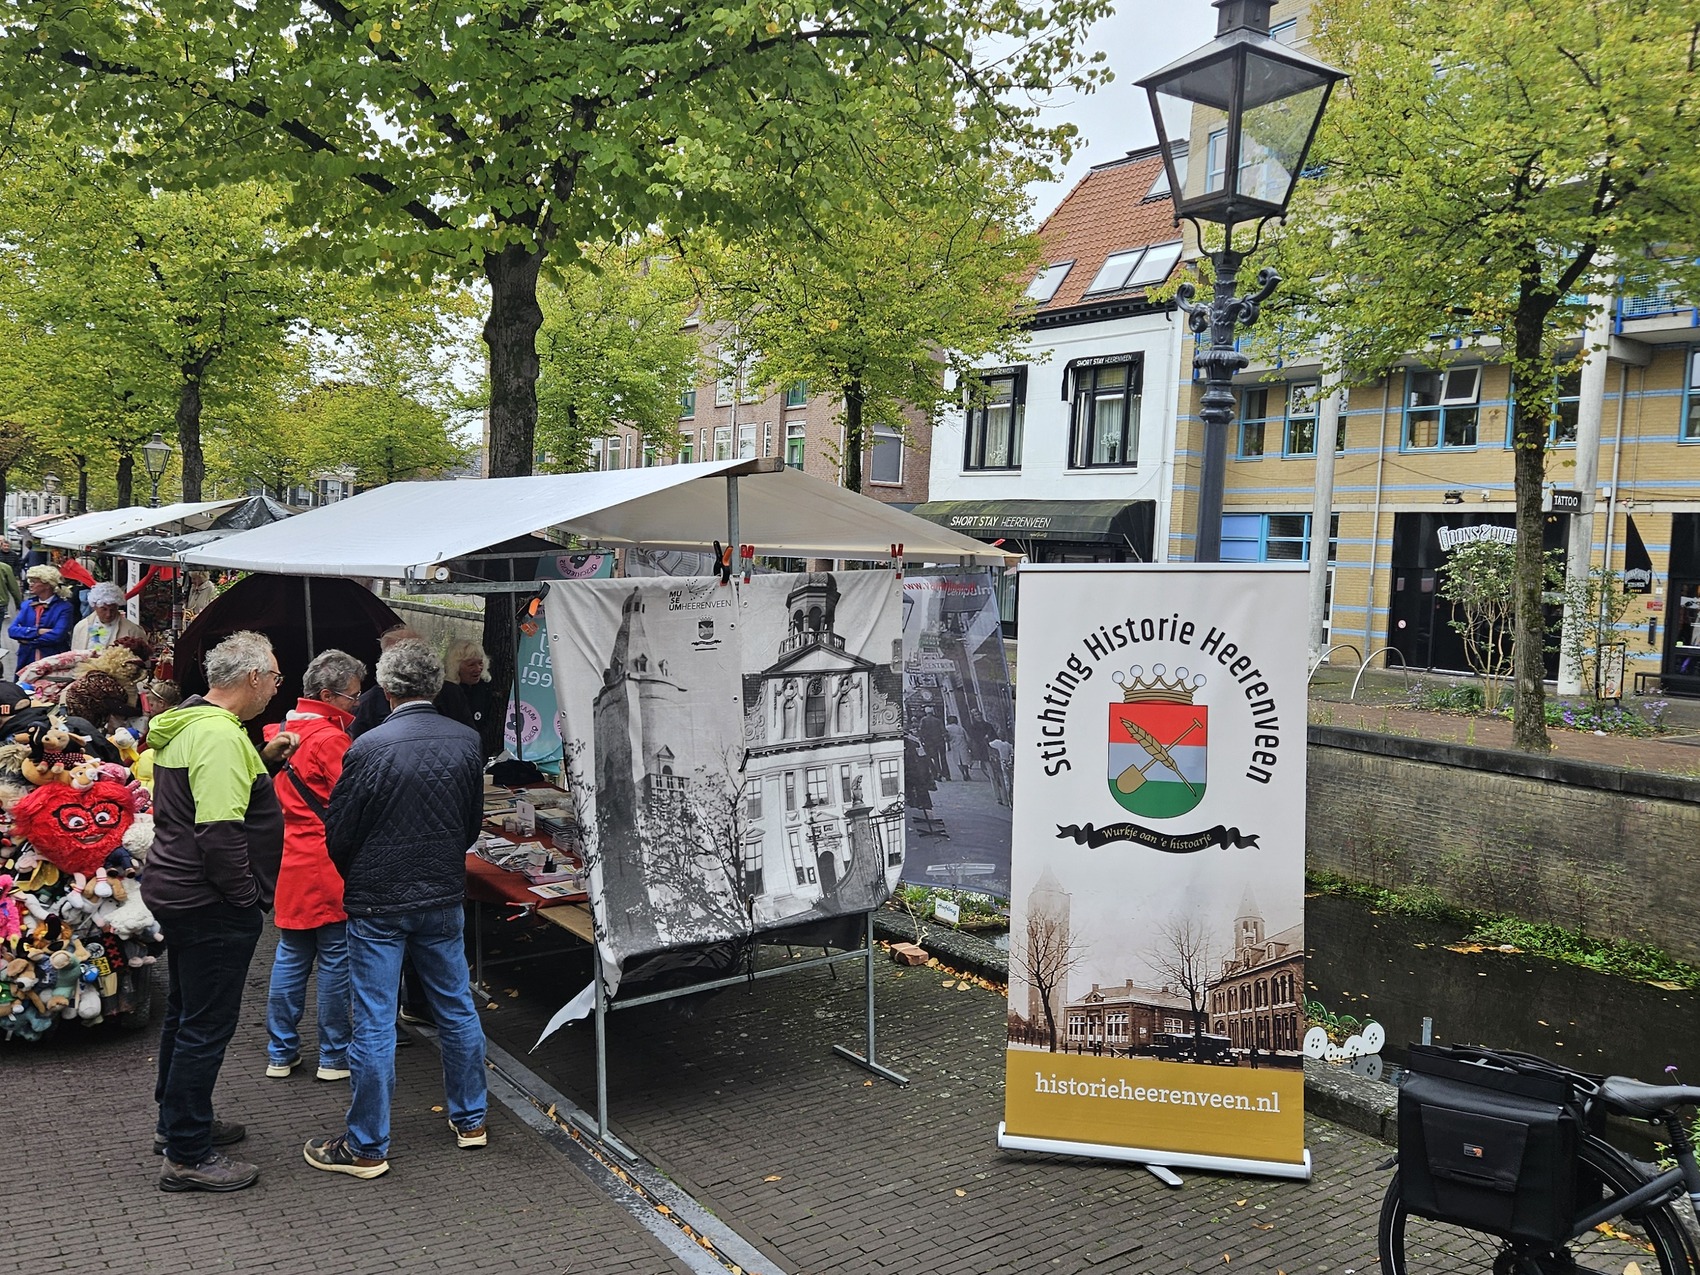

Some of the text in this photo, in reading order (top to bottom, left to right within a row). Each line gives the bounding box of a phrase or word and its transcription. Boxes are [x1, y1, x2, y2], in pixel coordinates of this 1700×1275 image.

[1076, 354, 1133, 367] SHORT STAY HEERENVEEN
[1554, 495, 1578, 507] TATTOO
[950, 516, 1051, 528] SHORT STAY HEERENVEEN
[1437, 525, 1479, 551] GOONS
[1037, 612, 1280, 784] Stichting Historie Heerenveen
[0, 704, 11, 715] 10
[1102, 824, 1138, 840] Wurkje
[1139, 831, 1158, 843] oan
[1169, 833, 1212, 850] histoarje
[1035, 1072, 1280, 1113] historieheerenveen.nl
